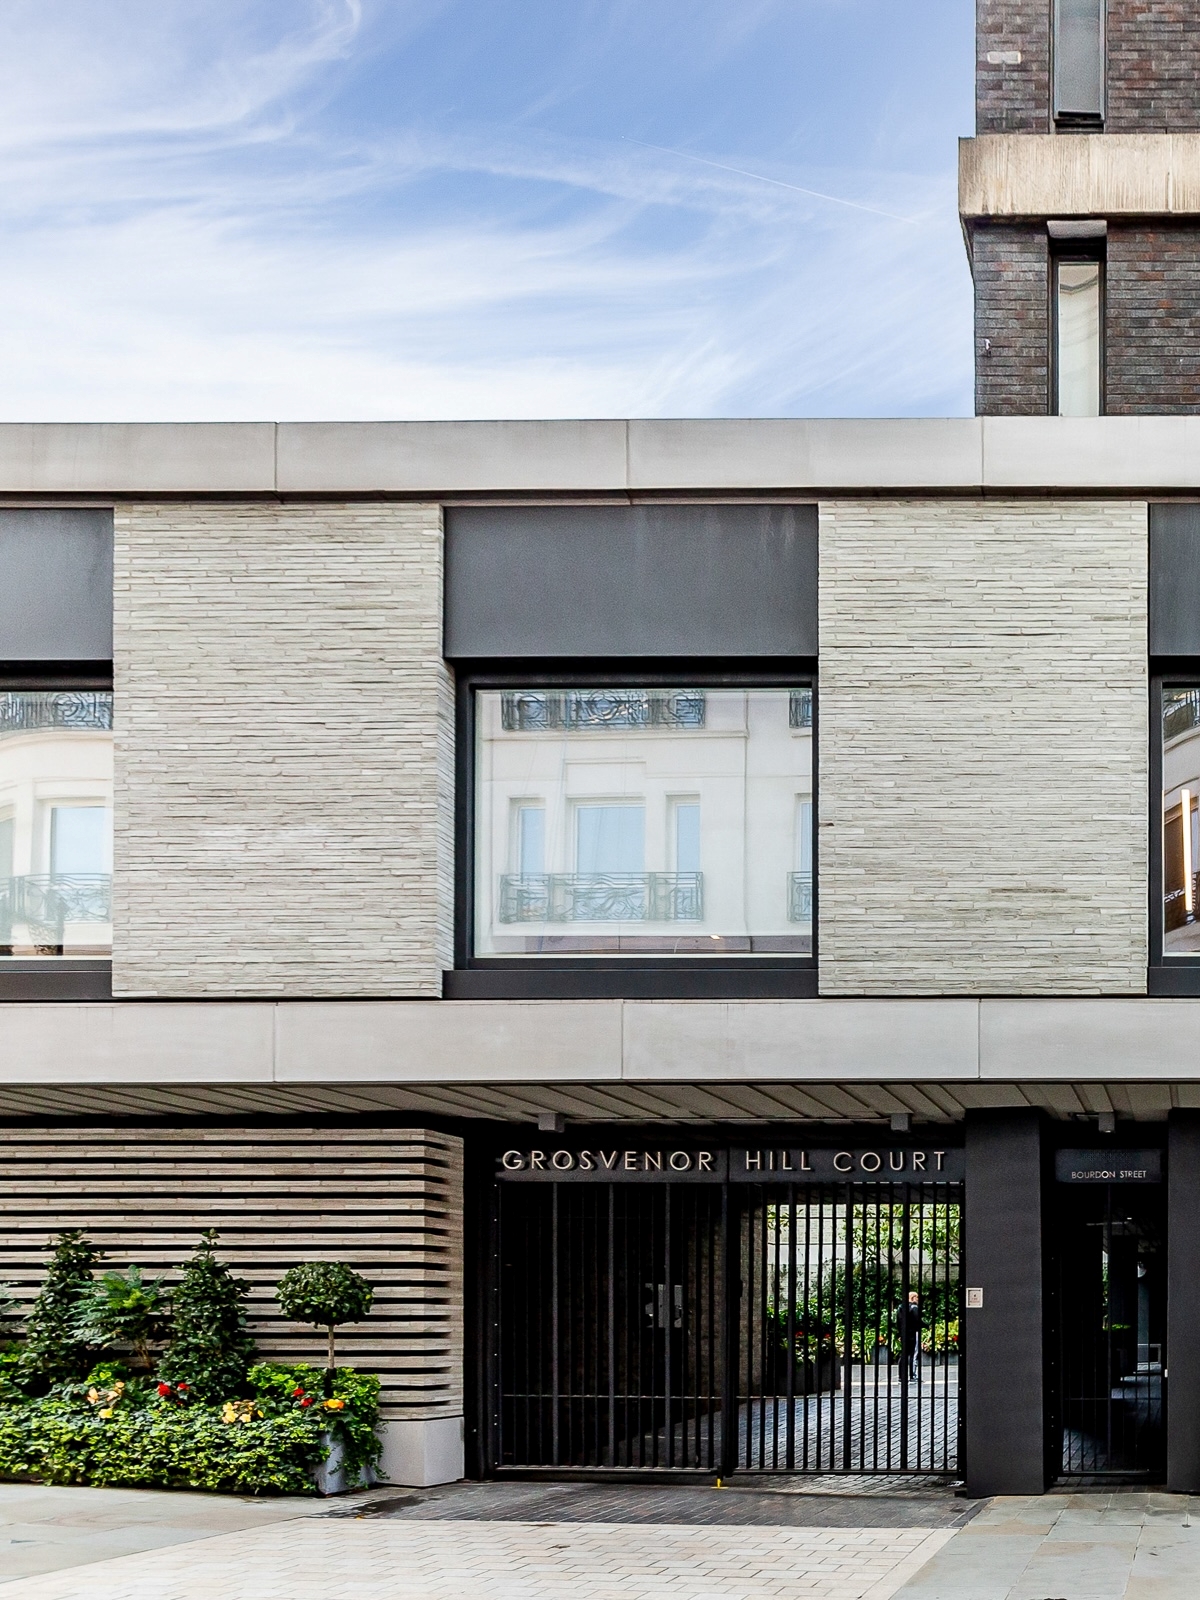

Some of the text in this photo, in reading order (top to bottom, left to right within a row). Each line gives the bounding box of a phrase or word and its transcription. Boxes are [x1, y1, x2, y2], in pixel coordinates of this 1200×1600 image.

[502, 1150, 945, 1172] GROSVENOR HILL COURT
[1071, 1170, 1147, 1179] BOURDON STREET
